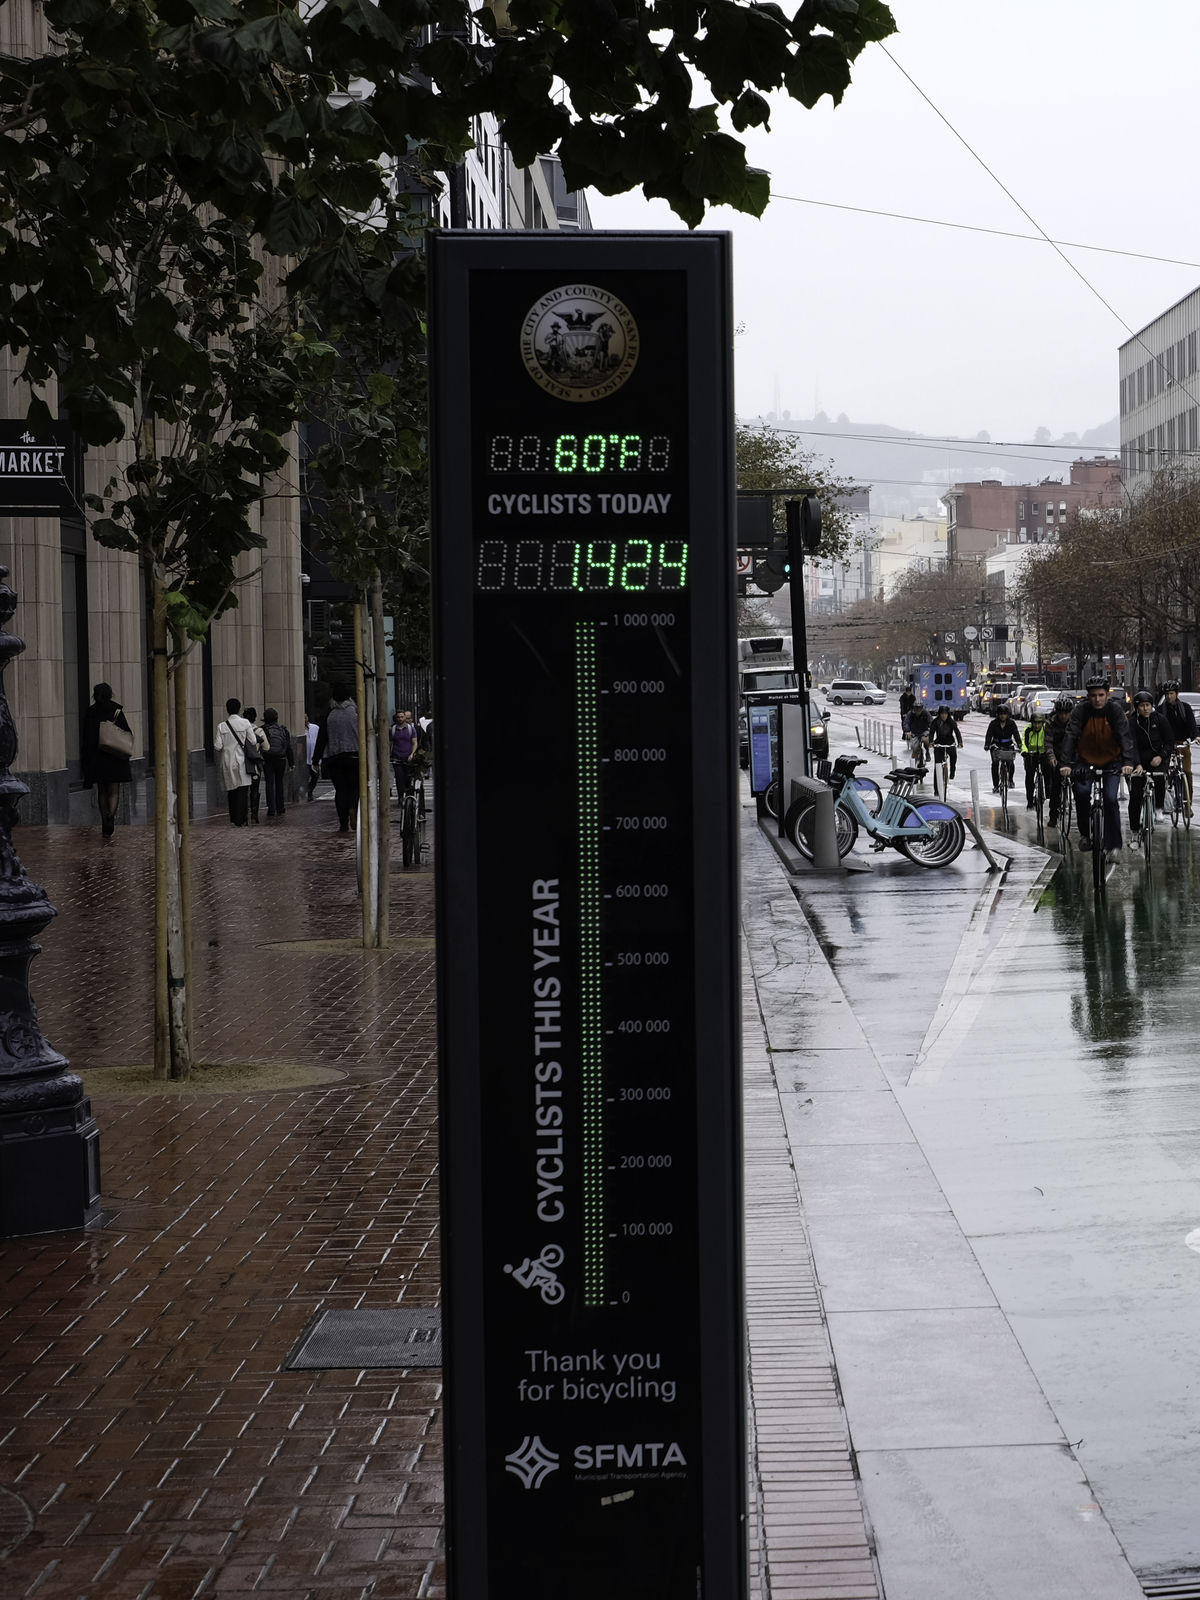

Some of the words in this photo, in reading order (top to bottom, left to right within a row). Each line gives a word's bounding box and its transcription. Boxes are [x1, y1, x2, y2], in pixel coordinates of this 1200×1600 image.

[540, 291, 562, 310] AND
[565, 286, 614, 305] COUNTY
[613, 303, 630, 318] OF
[524, 309, 540, 336] CITY
[624, 319, 638, 342] SAN
[523, 341, 534, 364] THE
[530, 365, 544, 381] OF
[591, 345, 637, 398] FRANCISCO
[545, 382, 571, 399] SEAL
[20, 431, 36, 444] the
[488, 493, 592, 515] CYCLISTS
[597, 493, 672, 515] TODAY
[533, 879, 560, 970] YEAR
[533, 977, 562, 1055] THIS
[535, 1062, 564, 1222] CYCLISTS
[622, 1290, 631, 1304] 0
[525, 1349, 606, 1373] Thank
[612, 1353, 661, 1376] you
[517, 1379, 555, 1401] for
[563, 1375, 676, 1404] bicycling
[573, 1442, 687, 1470] SFMTA
[575, 1473, 608, 1481] Municipal
[610, 1472, 659, 1480] Transportation
[661, 1471, 687, 1479] Agency
